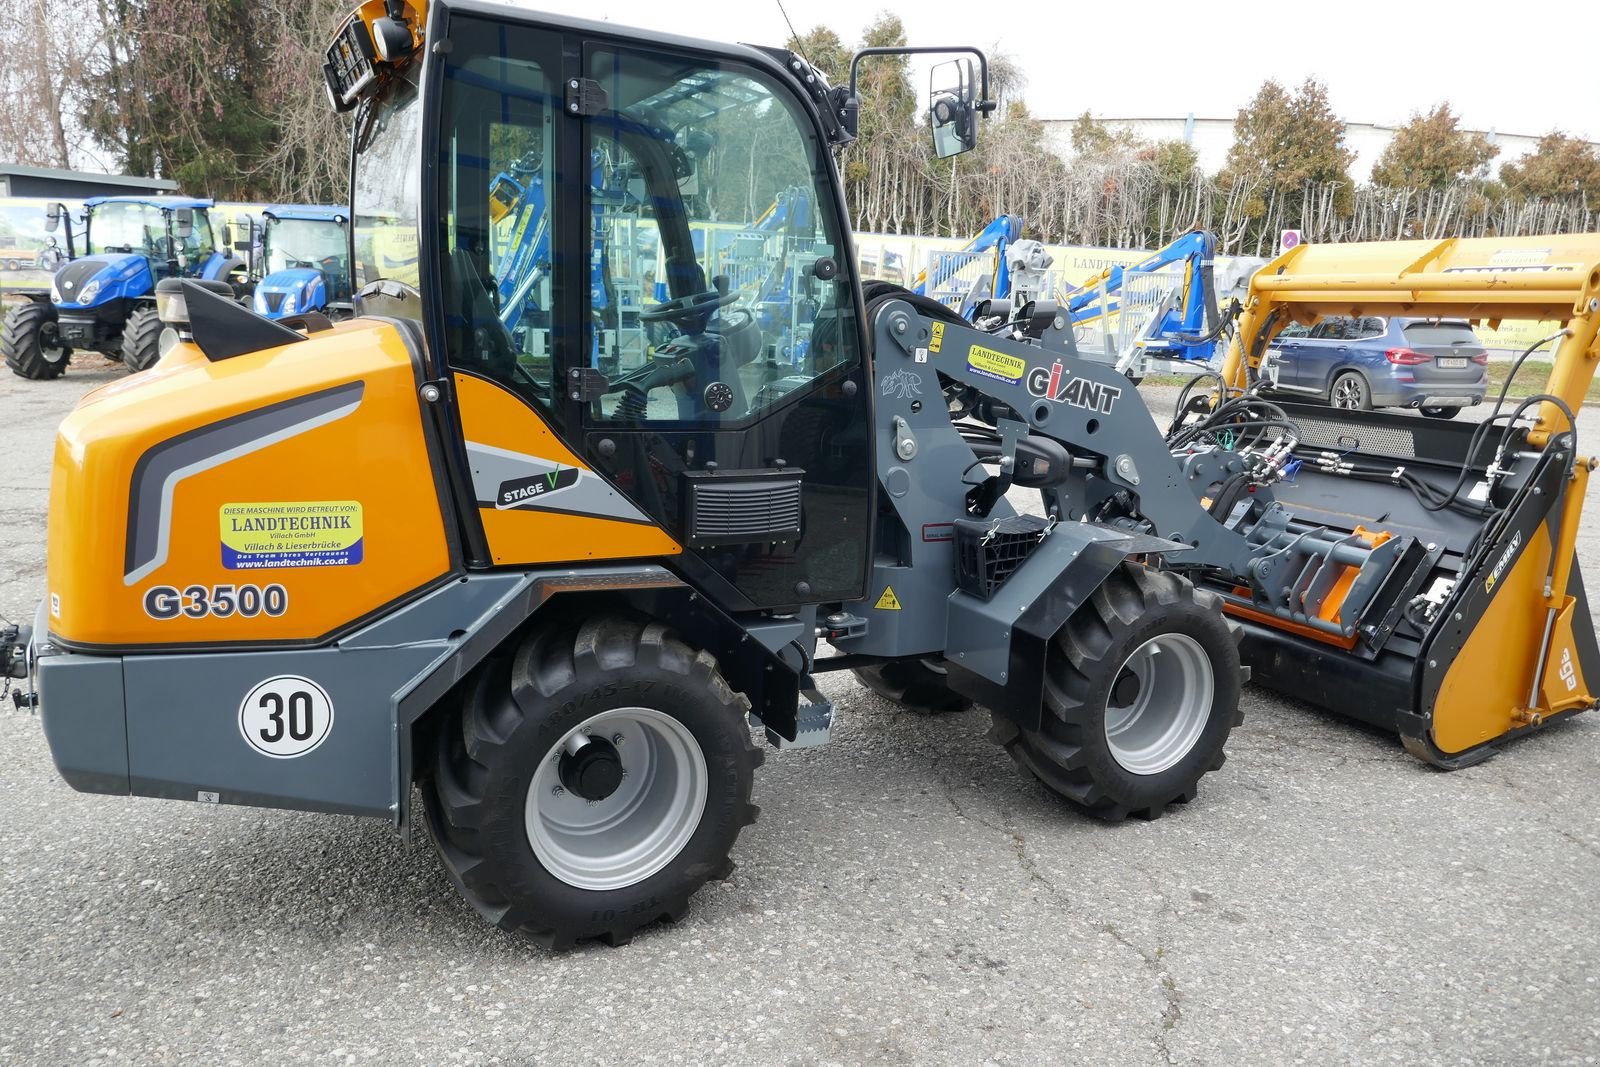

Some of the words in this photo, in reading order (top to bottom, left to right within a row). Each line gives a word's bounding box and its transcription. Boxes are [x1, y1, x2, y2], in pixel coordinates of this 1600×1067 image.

[972, 347, 1023, 369] LANDTECHNIK
[503, 482, 545, 502] STAGE
[224, 507, 245, 515] DIESE
[286, 506, 306, 514] WIRD
[231, 515, 352, 532] LANDTECHNIK
[244, 542, 275, 551] Villach
[276, 542, 283, 550] &
[285, 540, 342, 550] Lieserbrücke
[236, 557, 349, 569] www.landtechnik.co.at
[143, 583, 289, 621] G3500
[258, 690, 314, 743] 30
